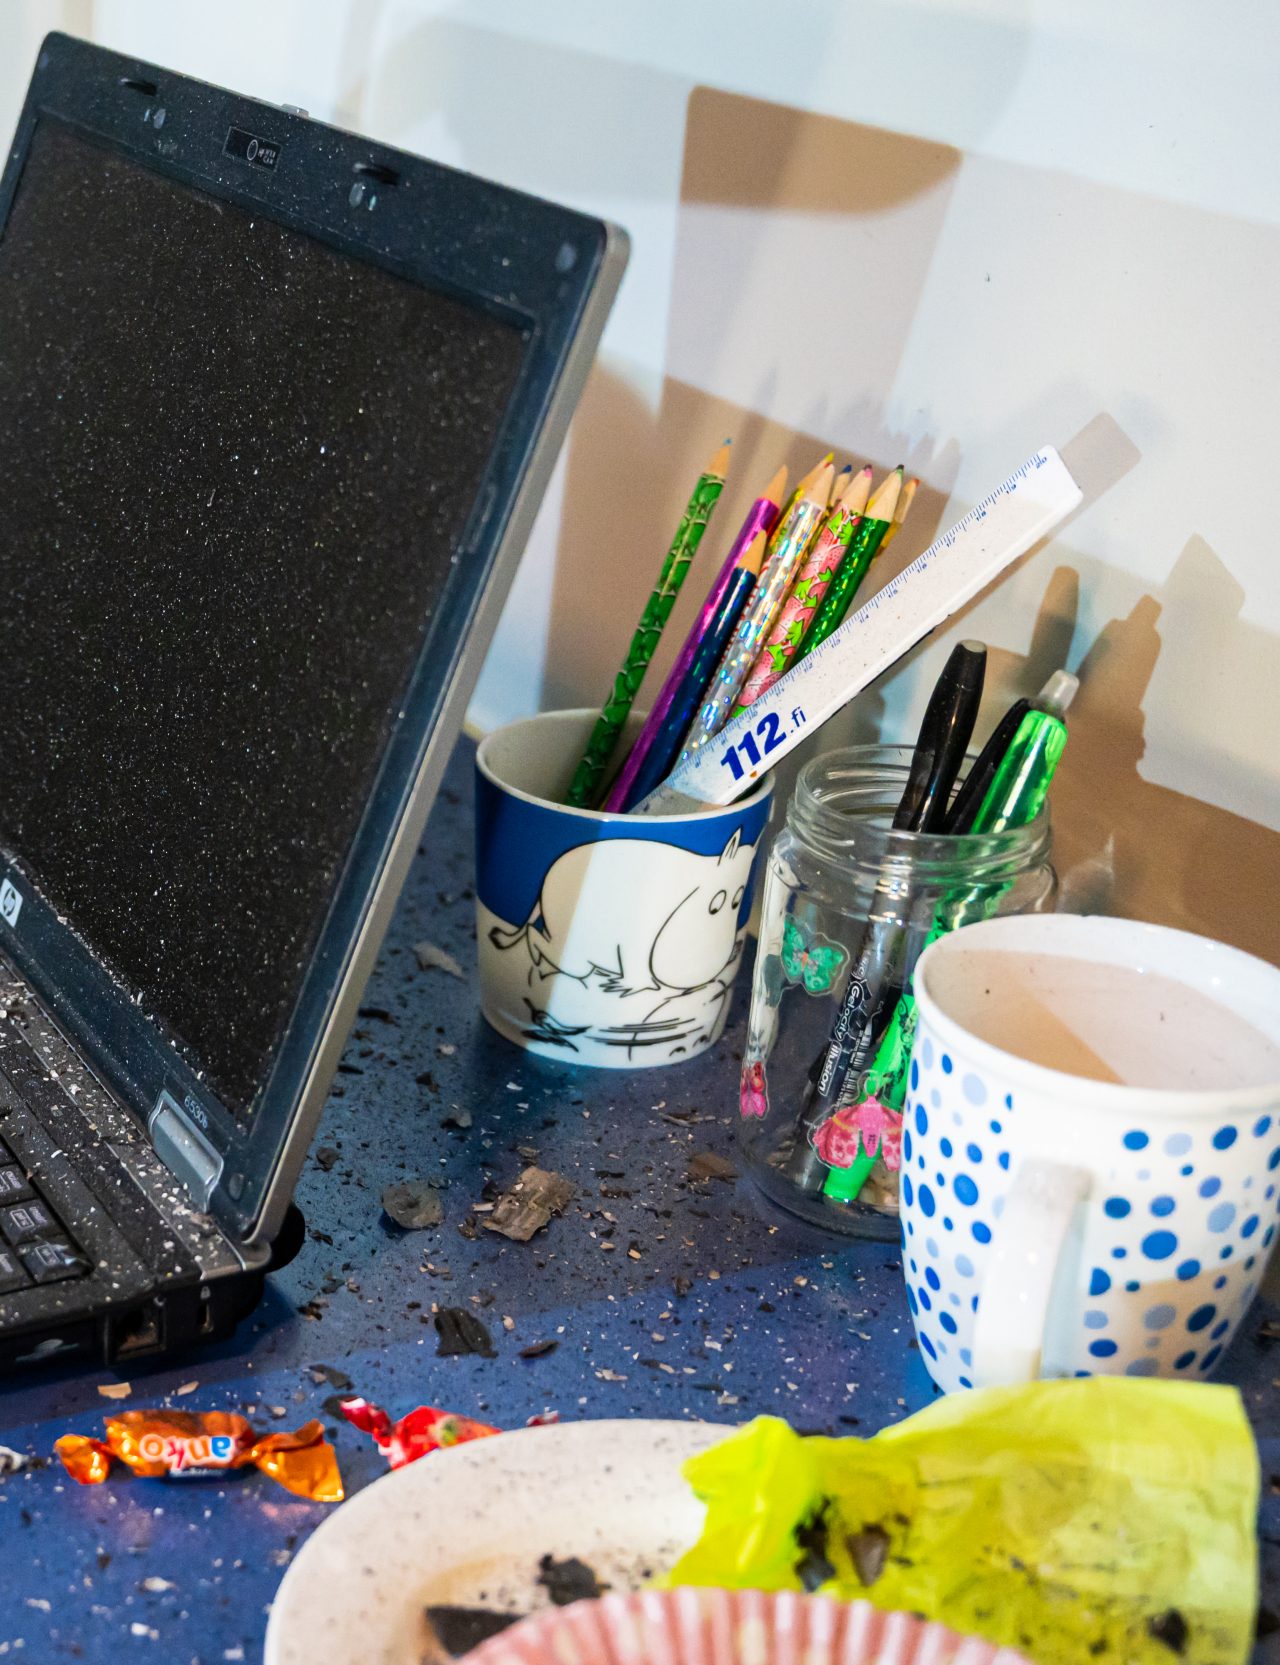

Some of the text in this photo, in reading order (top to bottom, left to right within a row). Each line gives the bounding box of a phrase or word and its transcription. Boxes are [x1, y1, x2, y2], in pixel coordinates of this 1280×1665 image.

[835, 986, 861, 1041] Gelocity
[819, 1043, 840, 1094] illusion
[141, 1435, 234, 1470] anko
